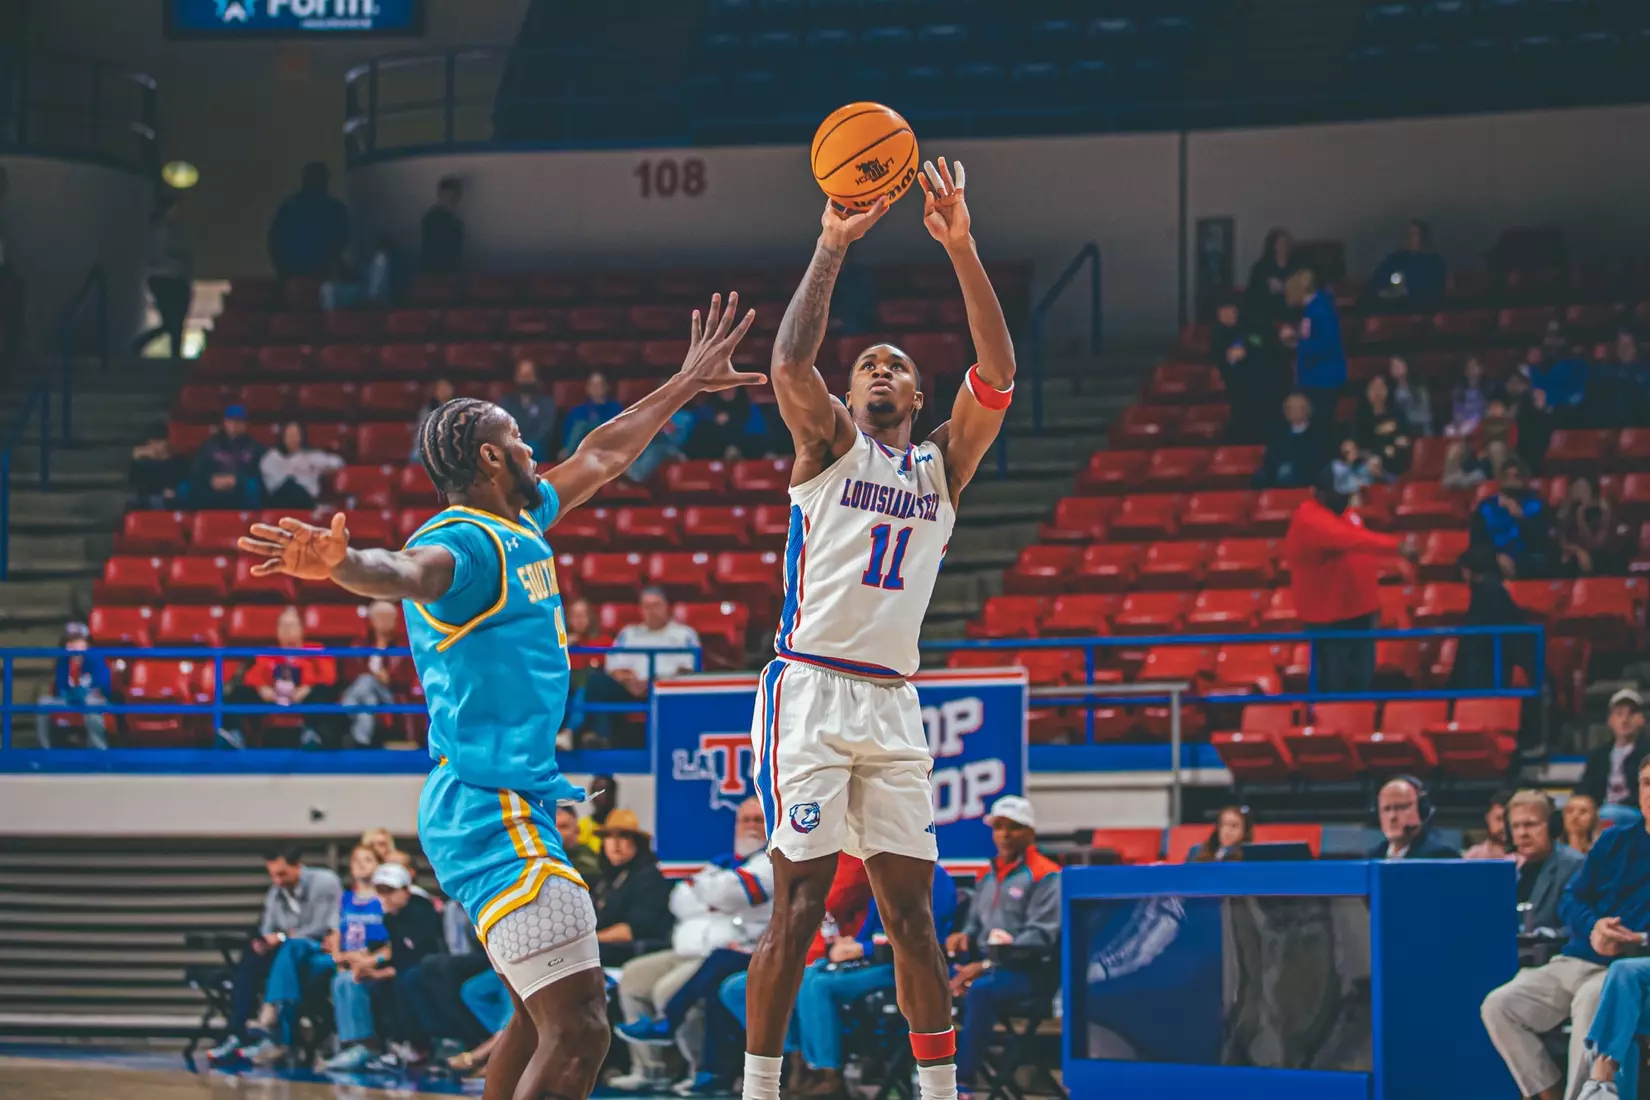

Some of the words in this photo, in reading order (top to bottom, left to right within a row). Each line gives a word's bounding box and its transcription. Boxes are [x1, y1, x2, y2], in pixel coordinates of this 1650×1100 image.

[632, 157, 709, 199] 108
[840, 478, 916, 519] LOUISIANA
[861, 523, 913, 590] 11
